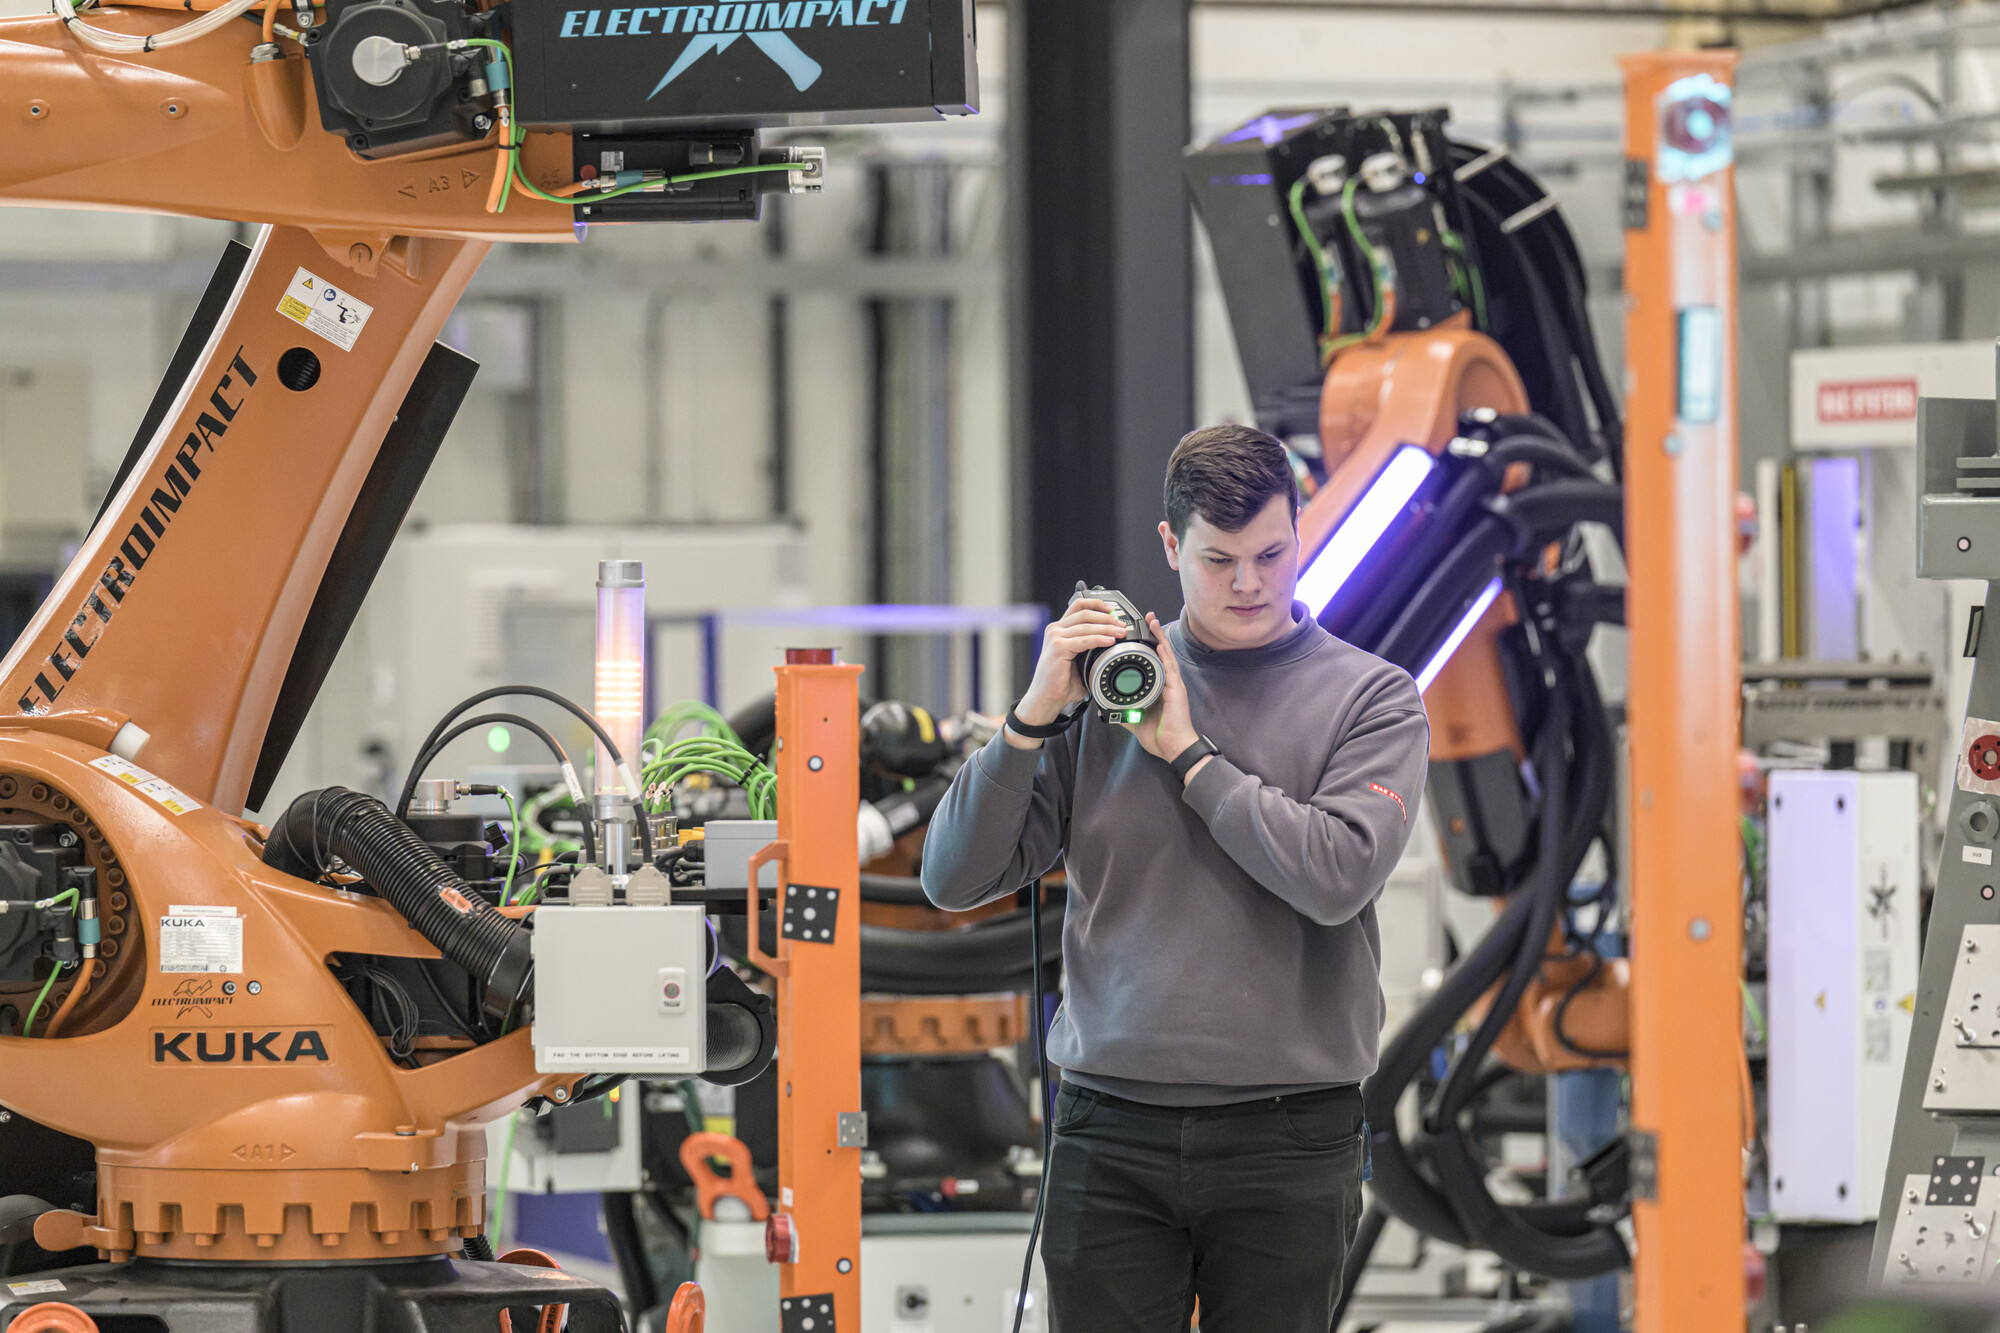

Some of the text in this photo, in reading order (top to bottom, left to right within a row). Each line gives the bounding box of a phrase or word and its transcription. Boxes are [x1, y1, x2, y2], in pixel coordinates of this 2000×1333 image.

[559, 0, 908, 38] ELECTROIMPACT
[429, 175, 450, 193] A3
[18, 345, 257, 717] ELECTROIMPACT
[161, 919, 205, 927] KUKA
[152, 996, 234, 1006] ELECTROIMPACT
[154, 1030, 329, 1062] KUKA
[251, 1144, 274, 1161] A1
